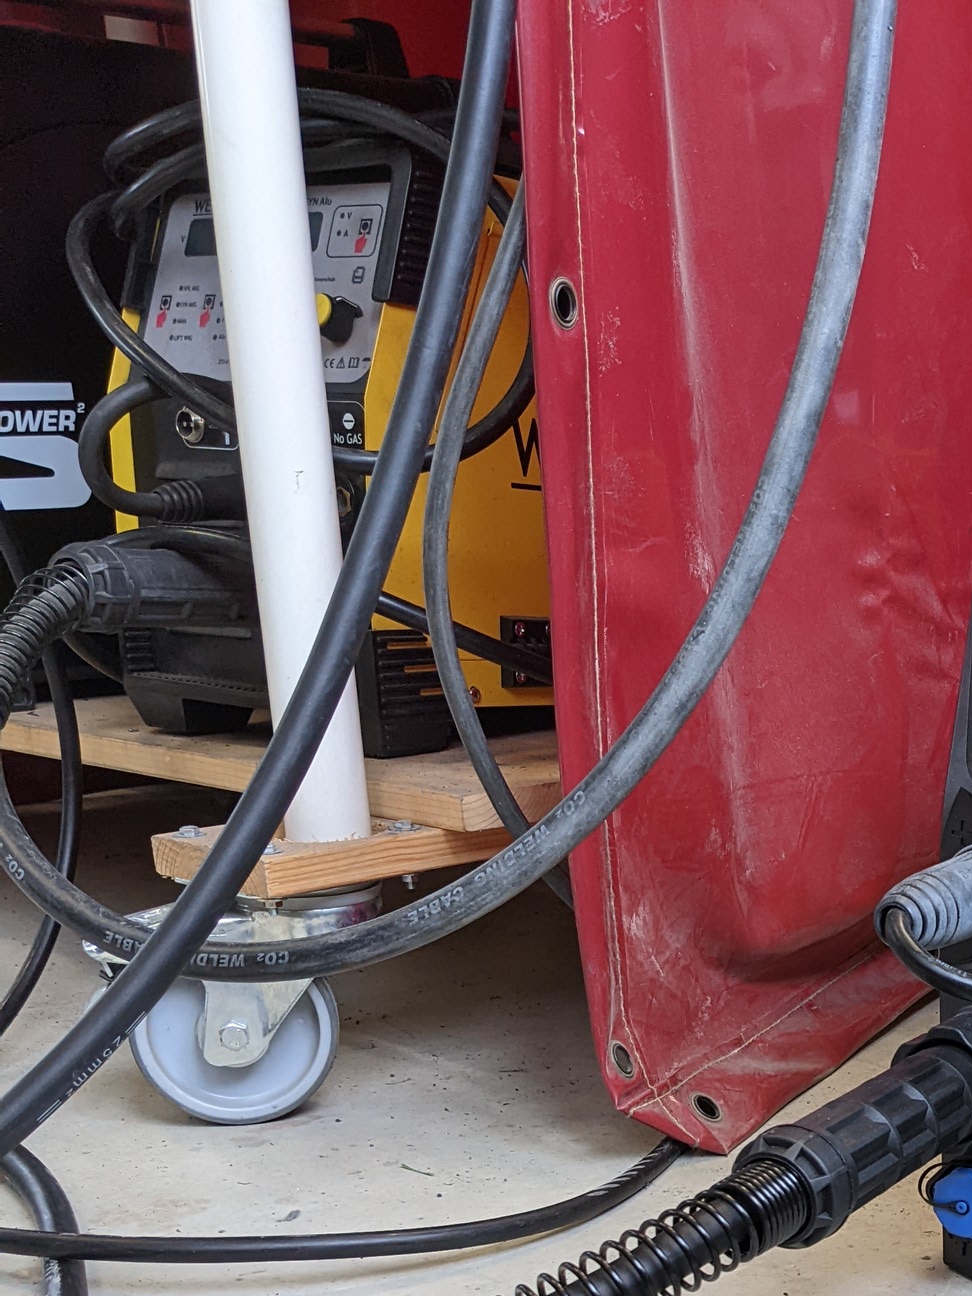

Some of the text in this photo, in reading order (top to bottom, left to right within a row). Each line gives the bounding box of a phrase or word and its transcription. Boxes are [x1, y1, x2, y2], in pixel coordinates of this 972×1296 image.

[333, 433, 363, 445] No GAS
[474, 824, 551, 886] WELDING
[407, 886, 465, 926] CABLE
